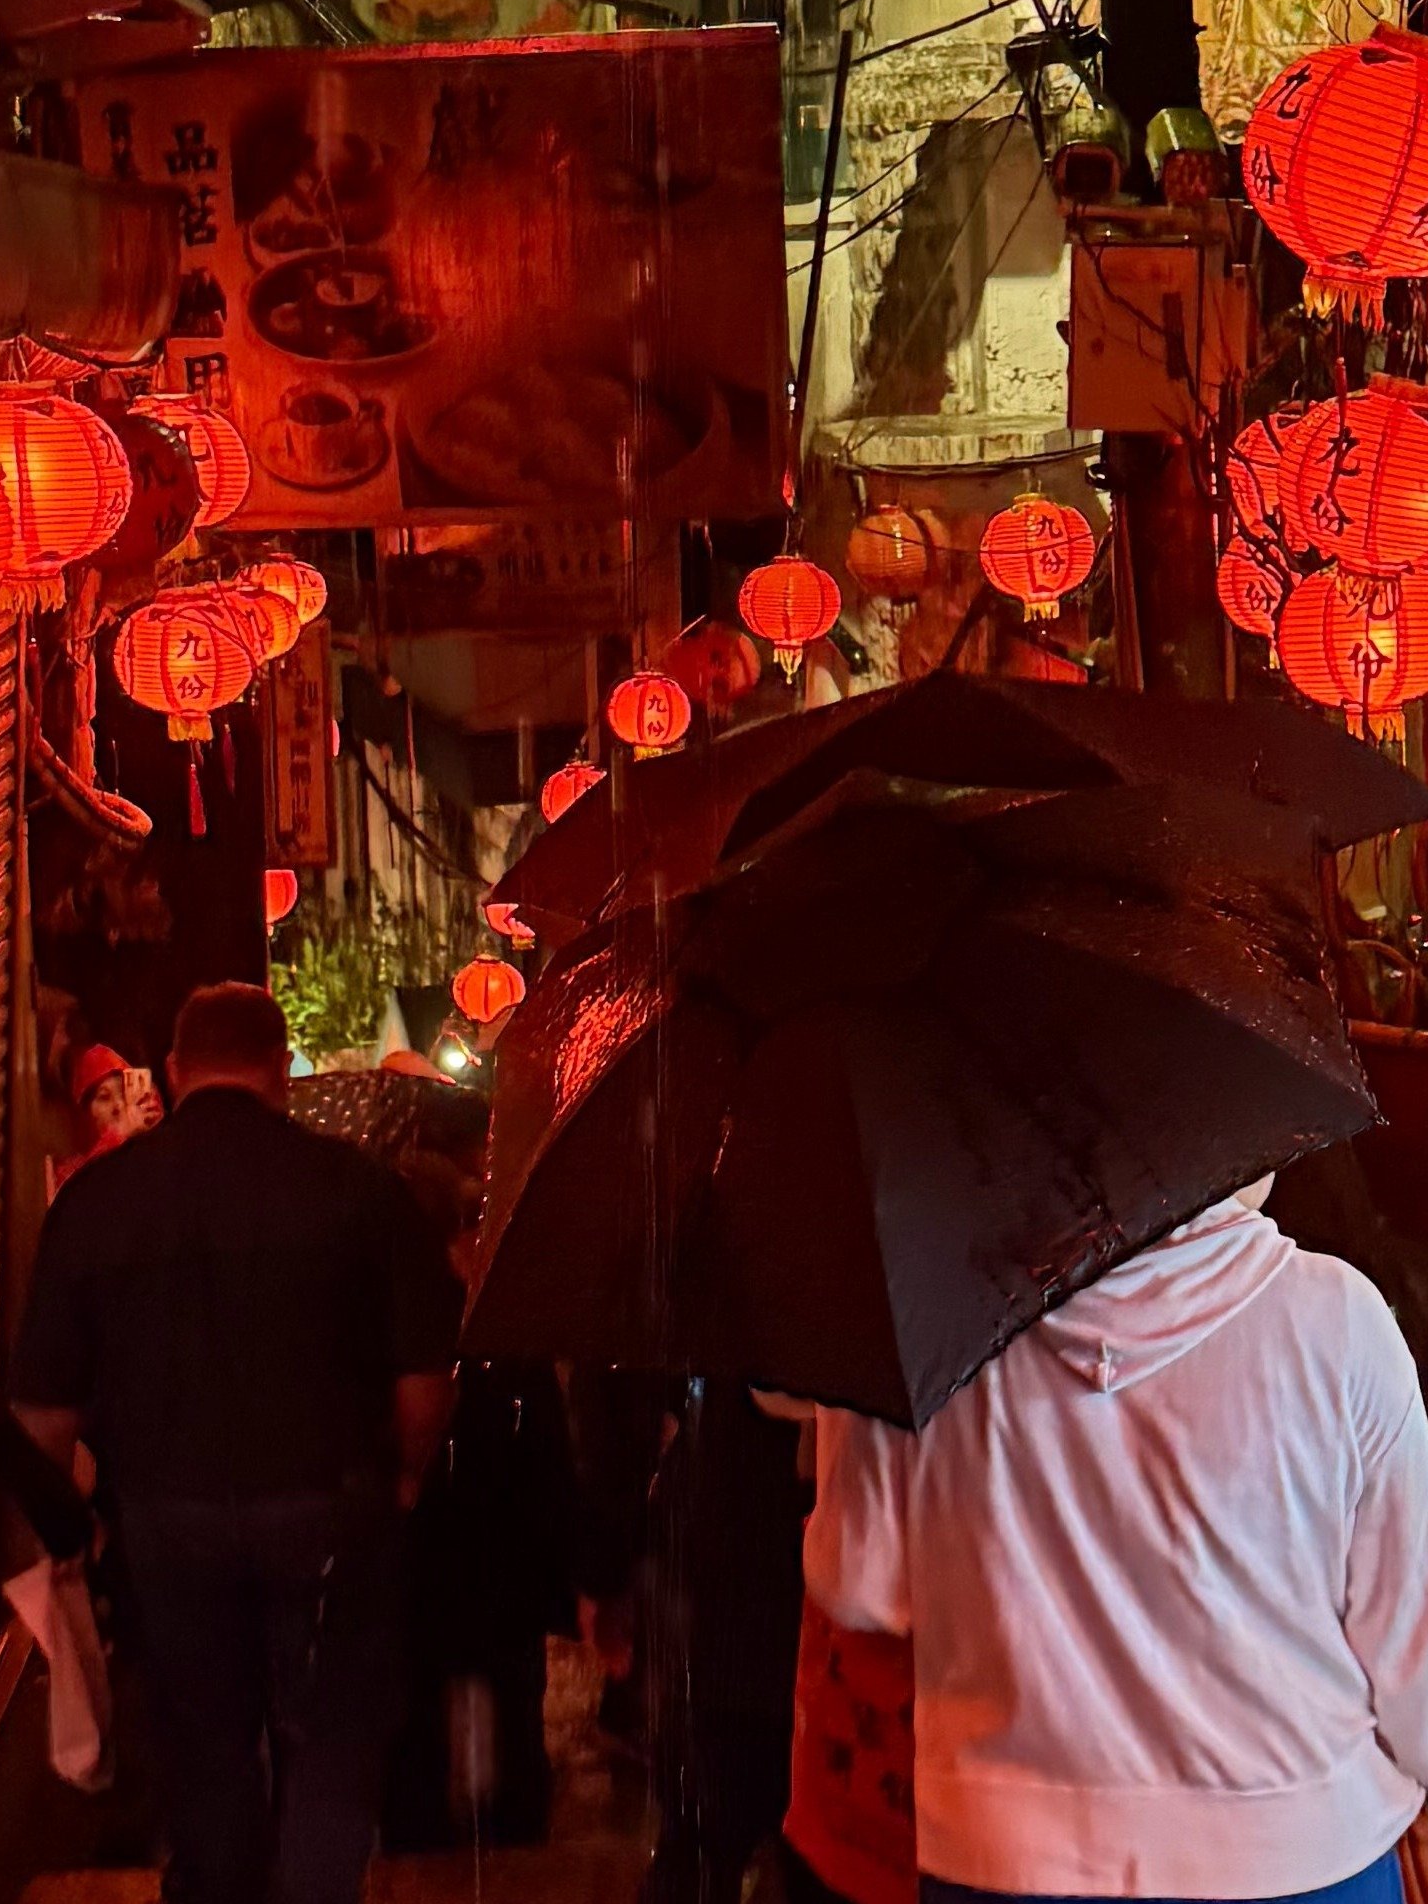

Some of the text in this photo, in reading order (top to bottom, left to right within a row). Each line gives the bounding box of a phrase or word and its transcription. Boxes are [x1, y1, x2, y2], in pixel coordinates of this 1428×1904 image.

[1038, 513, 1065, 575] 九份
[177, 629, 213, 699] 九份
[647, 692, 669, 739] 九份
